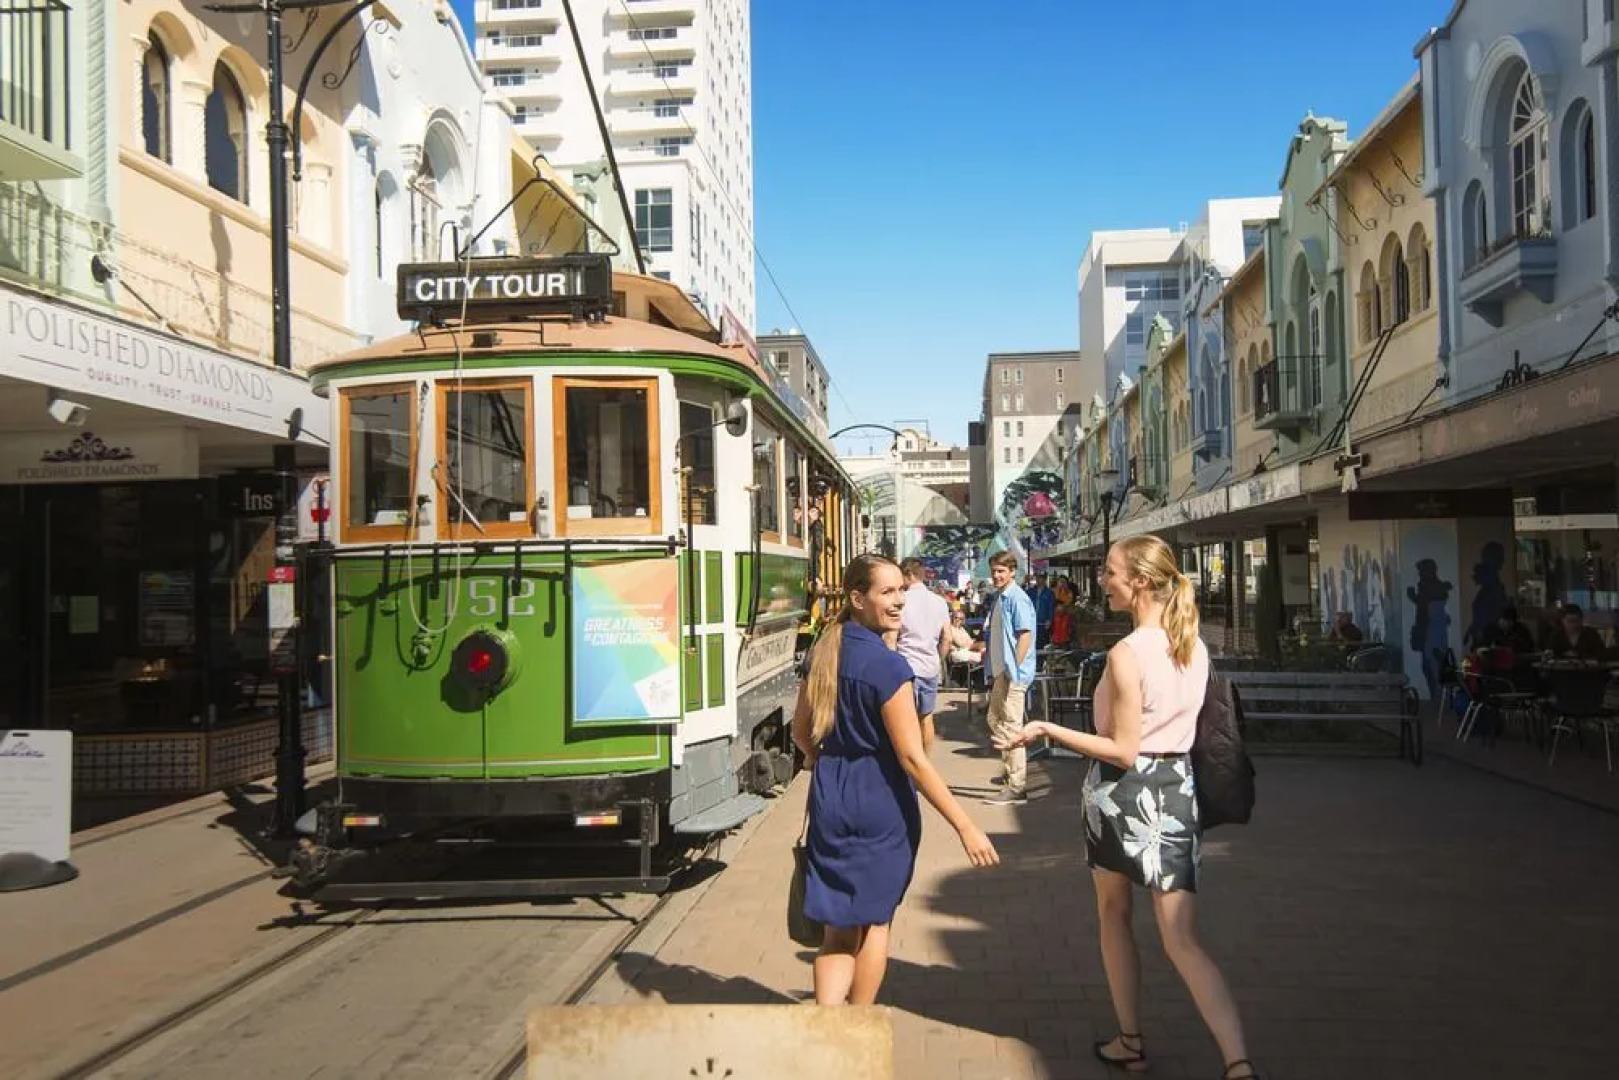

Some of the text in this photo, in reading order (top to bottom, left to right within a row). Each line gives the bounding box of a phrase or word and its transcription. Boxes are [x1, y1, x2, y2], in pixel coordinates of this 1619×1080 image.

[415, 275, 481, 302] CITY
[486, 272, 566, 298] TOUR
[7, 300, 273, 404] POLISHED DIAMONDS
[87, 367, 139, 390] QUALITY
[17, 463, 159, 480] POLISHED DIAMONDS
